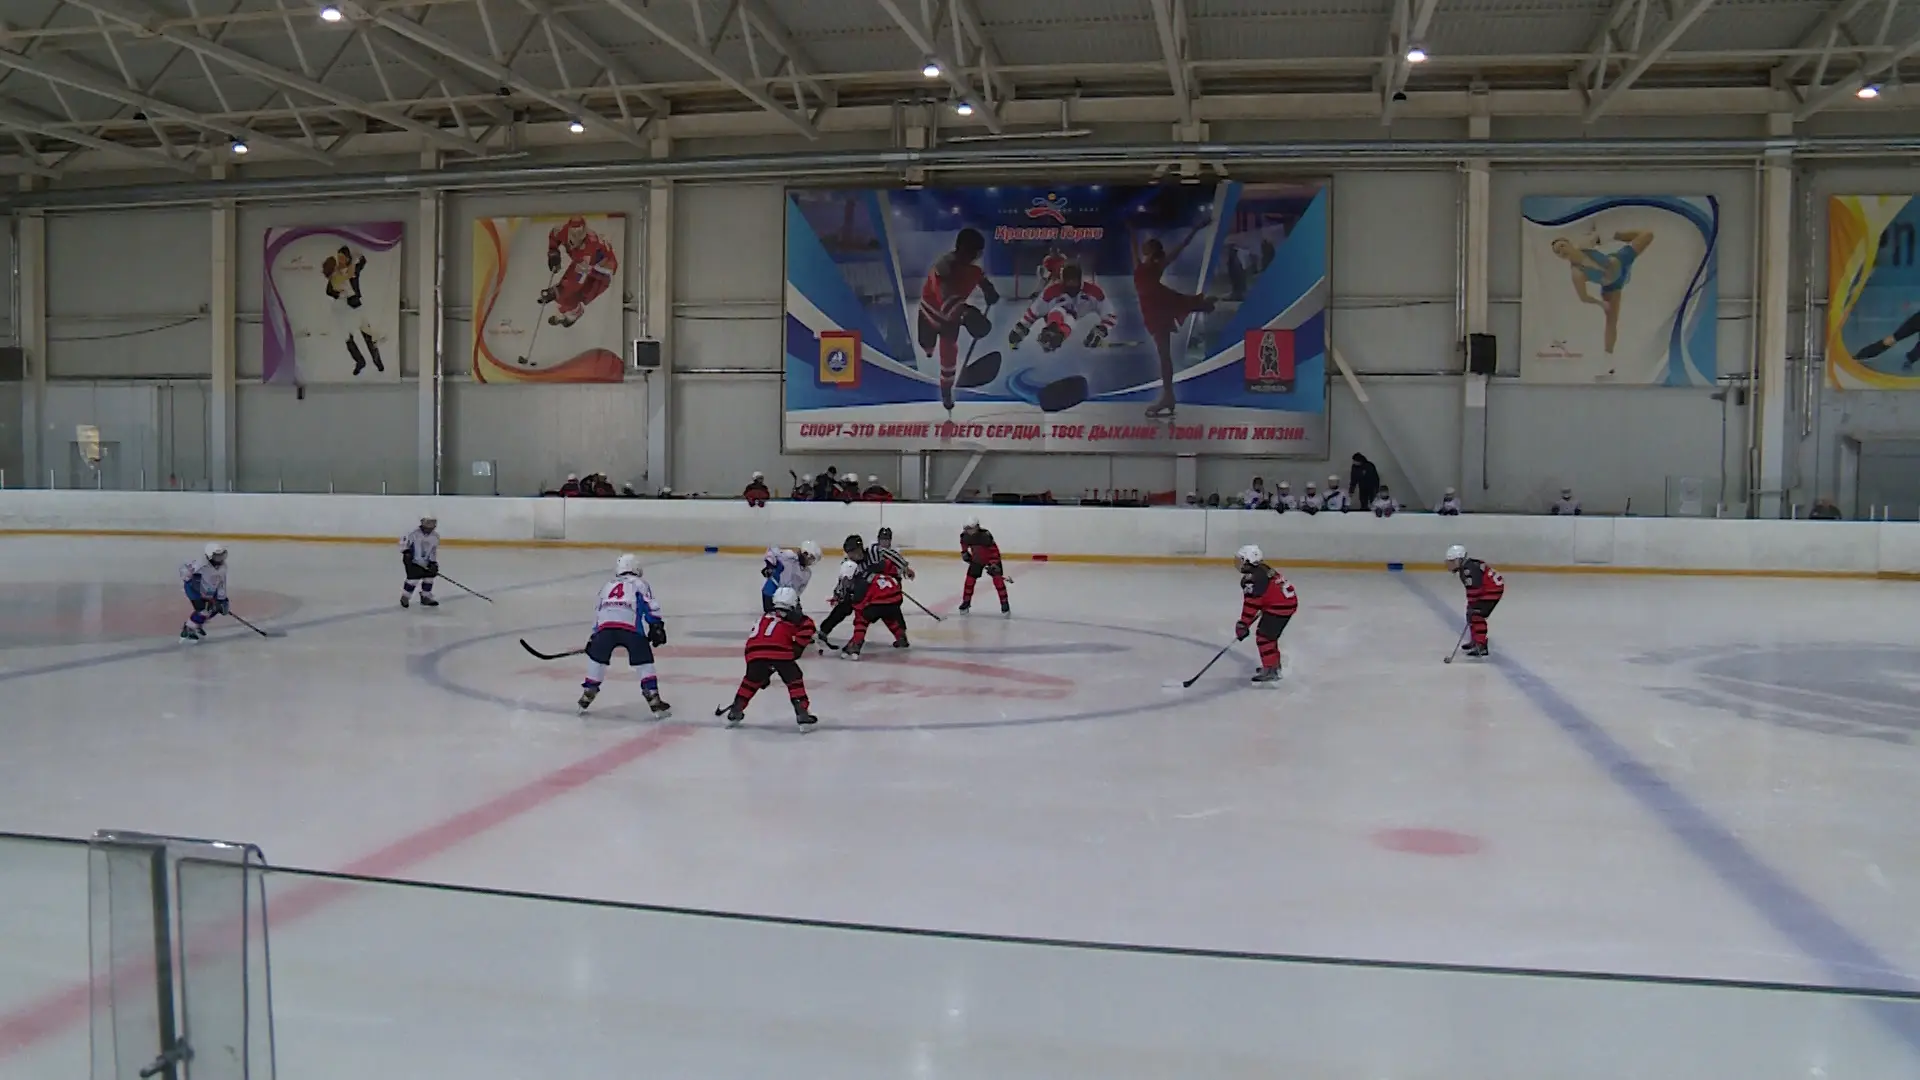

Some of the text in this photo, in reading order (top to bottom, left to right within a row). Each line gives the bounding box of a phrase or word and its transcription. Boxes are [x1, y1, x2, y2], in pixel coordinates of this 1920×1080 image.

[877, 423, 930, 438] БИЕНИЕ
[934, 423, 984, 438] ТОЕГО
[1051, 424, 1085, 438] ТВОЕ
[1168, 424, 1204, 440] ТВОЙ
[1207, 426, 1249, 440] РИТМ
[607, 582, 625, 600] 4
